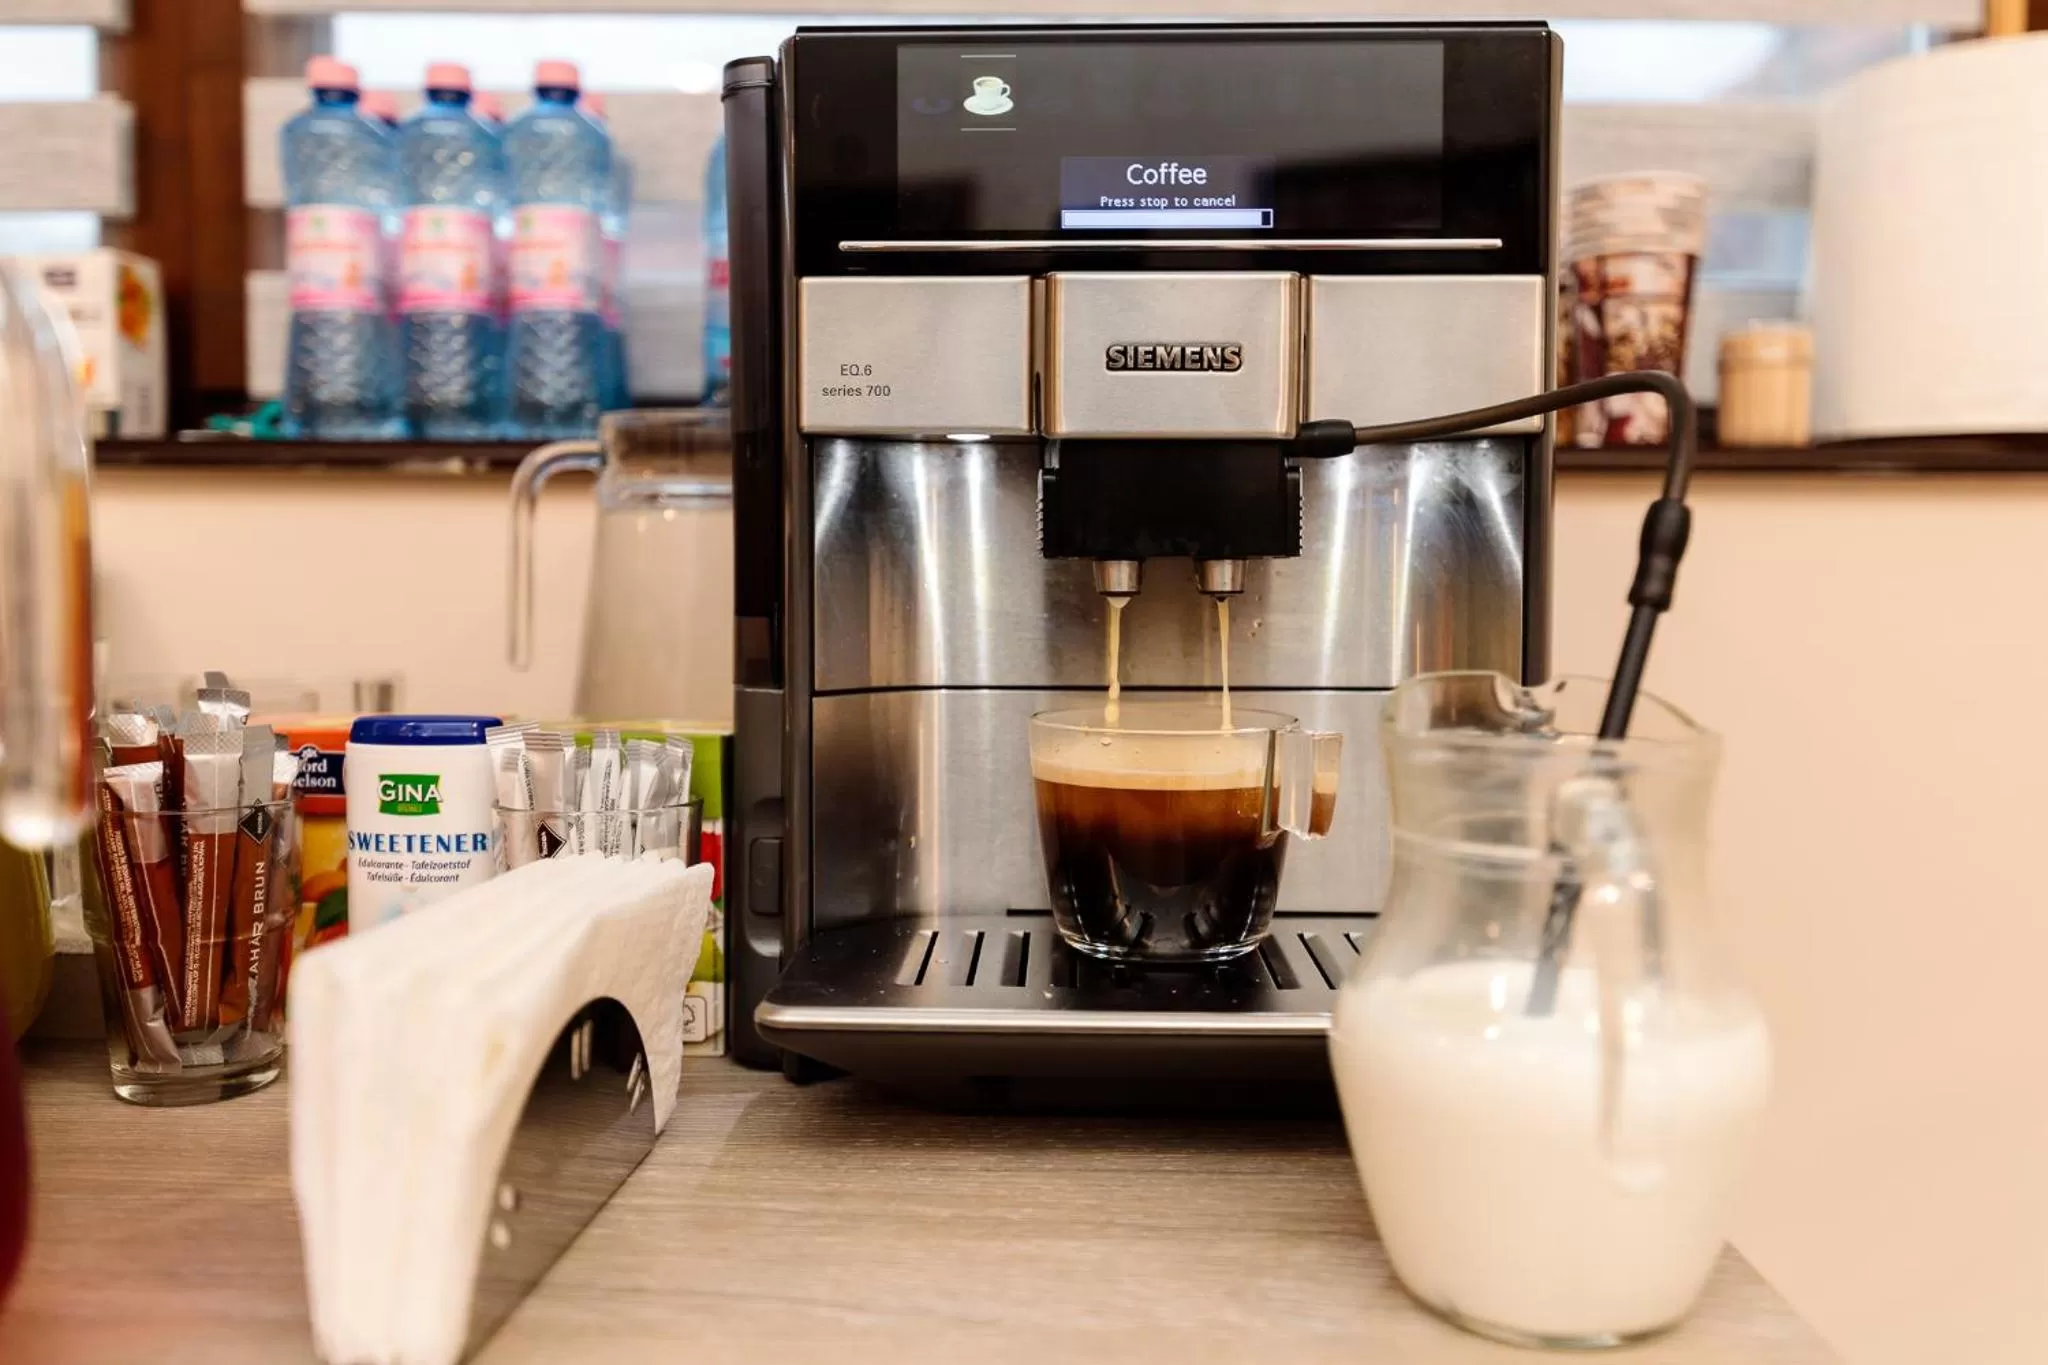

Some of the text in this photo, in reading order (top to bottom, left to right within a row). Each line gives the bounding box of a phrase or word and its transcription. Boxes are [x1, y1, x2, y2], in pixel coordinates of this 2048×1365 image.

[1126, 163, 1208, 185] Coffee
[1100, 195, 1236, 210] Press stop to cancel
[1106, 344, 1242, 371] SIEMENS
[840, 364, 872, 376] EQ.6
[822, 385, 891, 397] series 700
[299, 758, 328, 774] ord
[293, 774, 336, 788] elson
[377, 780, 443, 802] GINA
[348, 832, 488, 854] SWEETENER
[411, 860, 471, 870] Tafelzoetstof
[253, 861, 266, 914] BRUN
